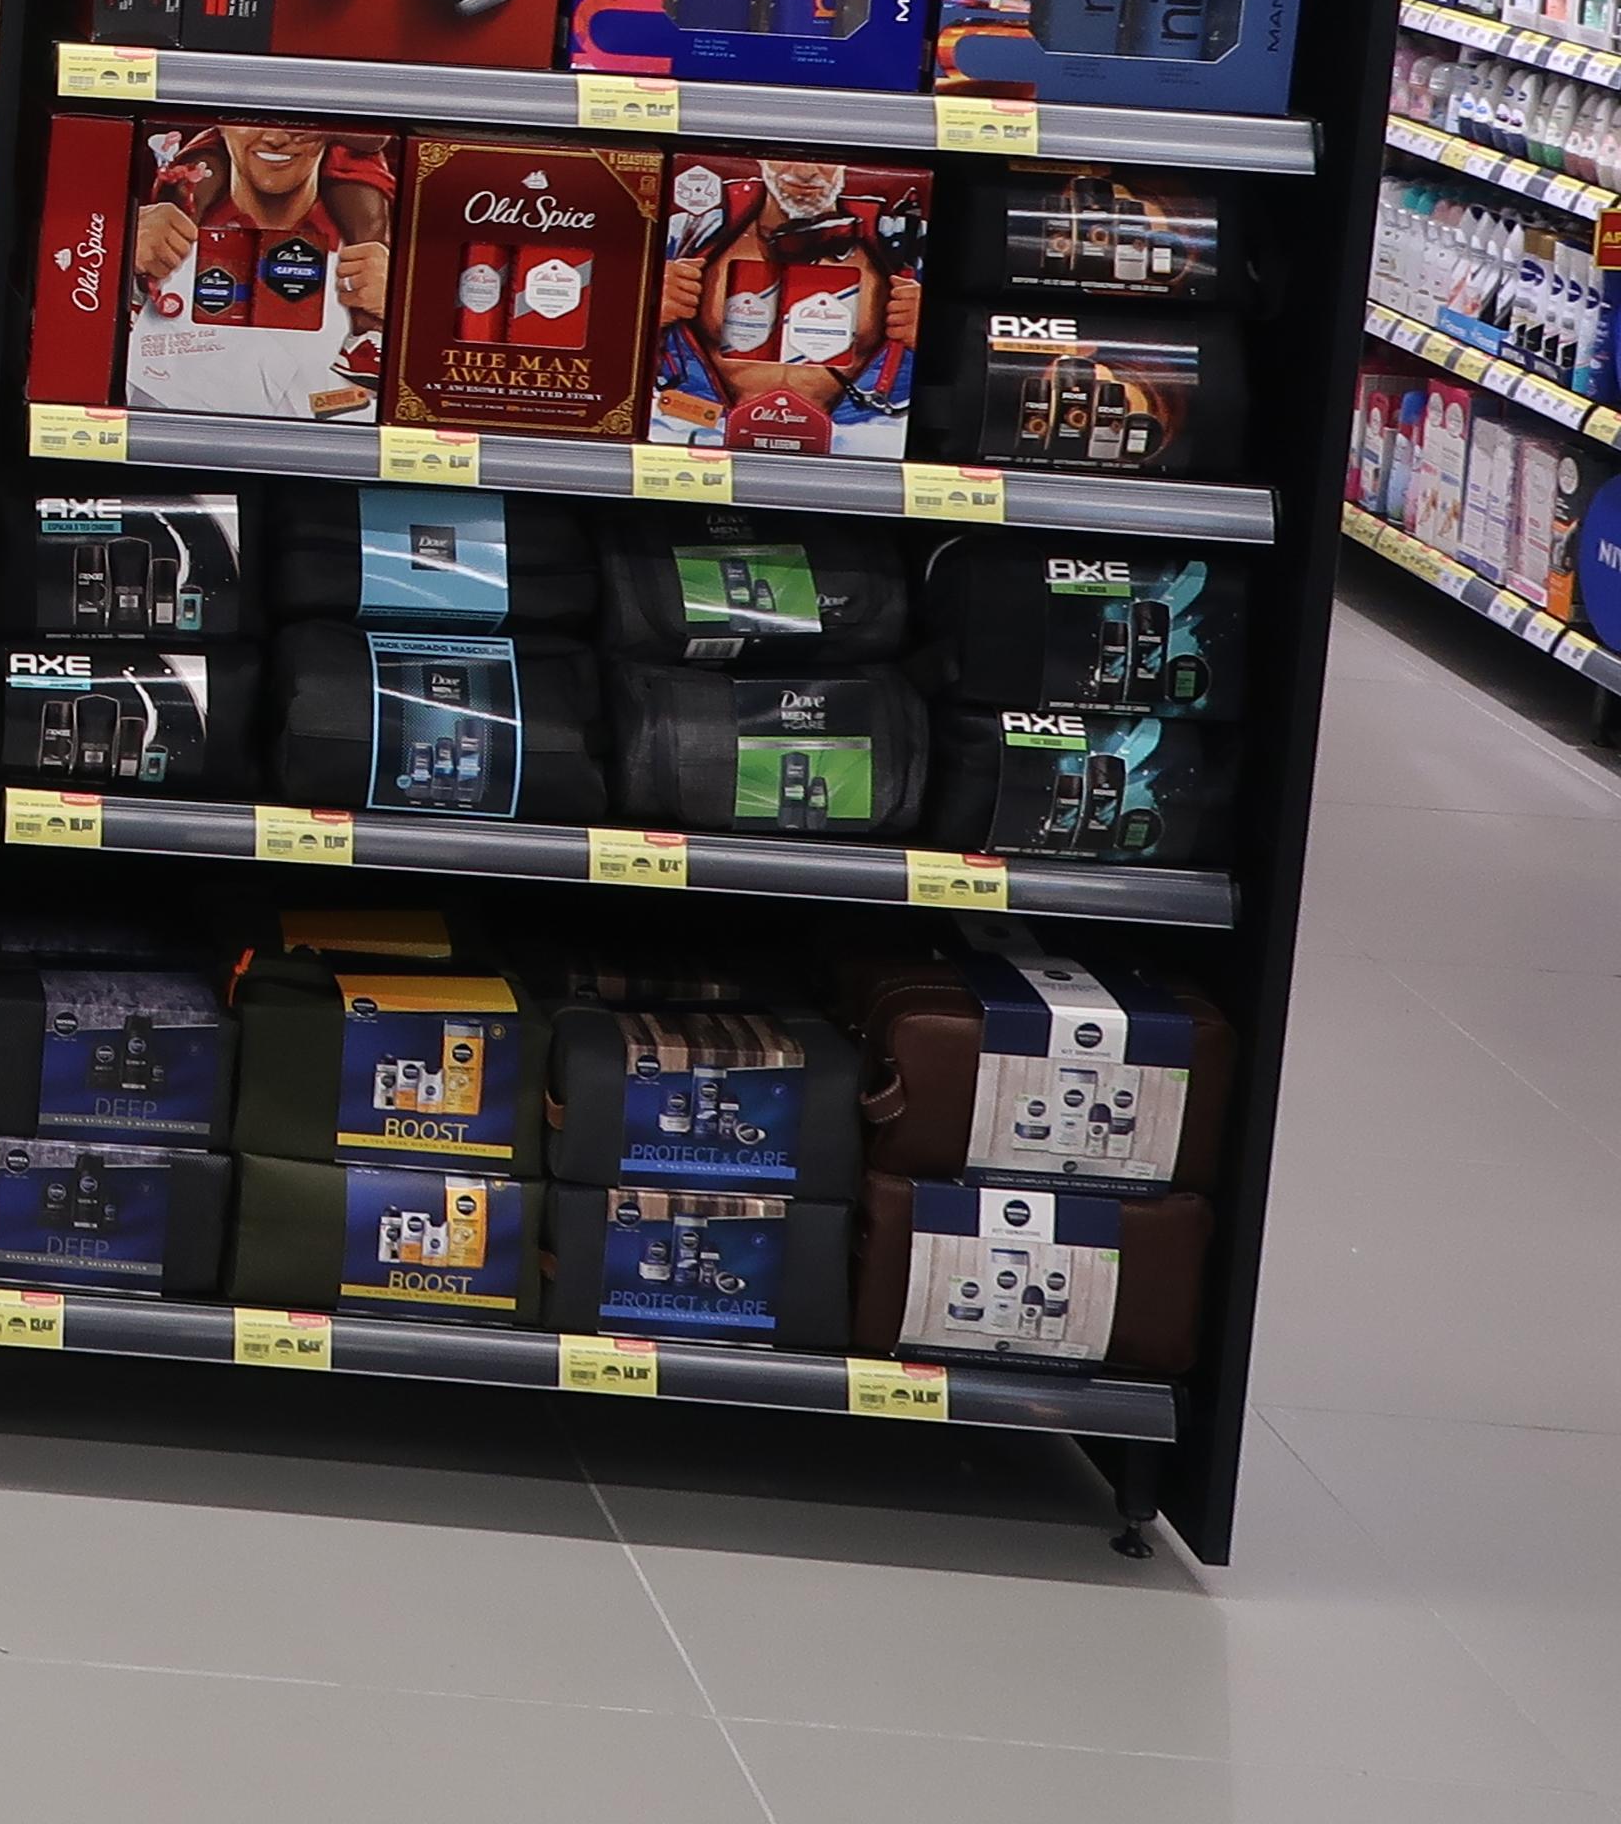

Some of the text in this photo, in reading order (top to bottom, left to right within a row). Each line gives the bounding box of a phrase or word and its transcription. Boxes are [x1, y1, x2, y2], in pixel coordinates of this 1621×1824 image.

[465, 192, 595, 232] Old Spice
[72, 213, 106, 313] Old Spice
[989, 315, 1078, 340] AXE
[442, 350, 592, 373] THE MAN
[442, 368, 590, 390] AWAKENS
[1047, 559, 1131, 582] AXE
[9, 653, 91, 675] AXE
[779, 690, 826, 710] Dove
[780, 709, 812, 723] MEN
[1001, 712, 1086, 735] AXE
[94, 1098, 158, 1118] DEEP
[384, 1117, 469, 1141] BOOST
[629, 1143, 718, 1165] PROTECT
[734, 1150, 789, 1167] CARE
[46, 1236, 110, 1257] DEEP
[388, 1271, 472, 1294] BOOST
